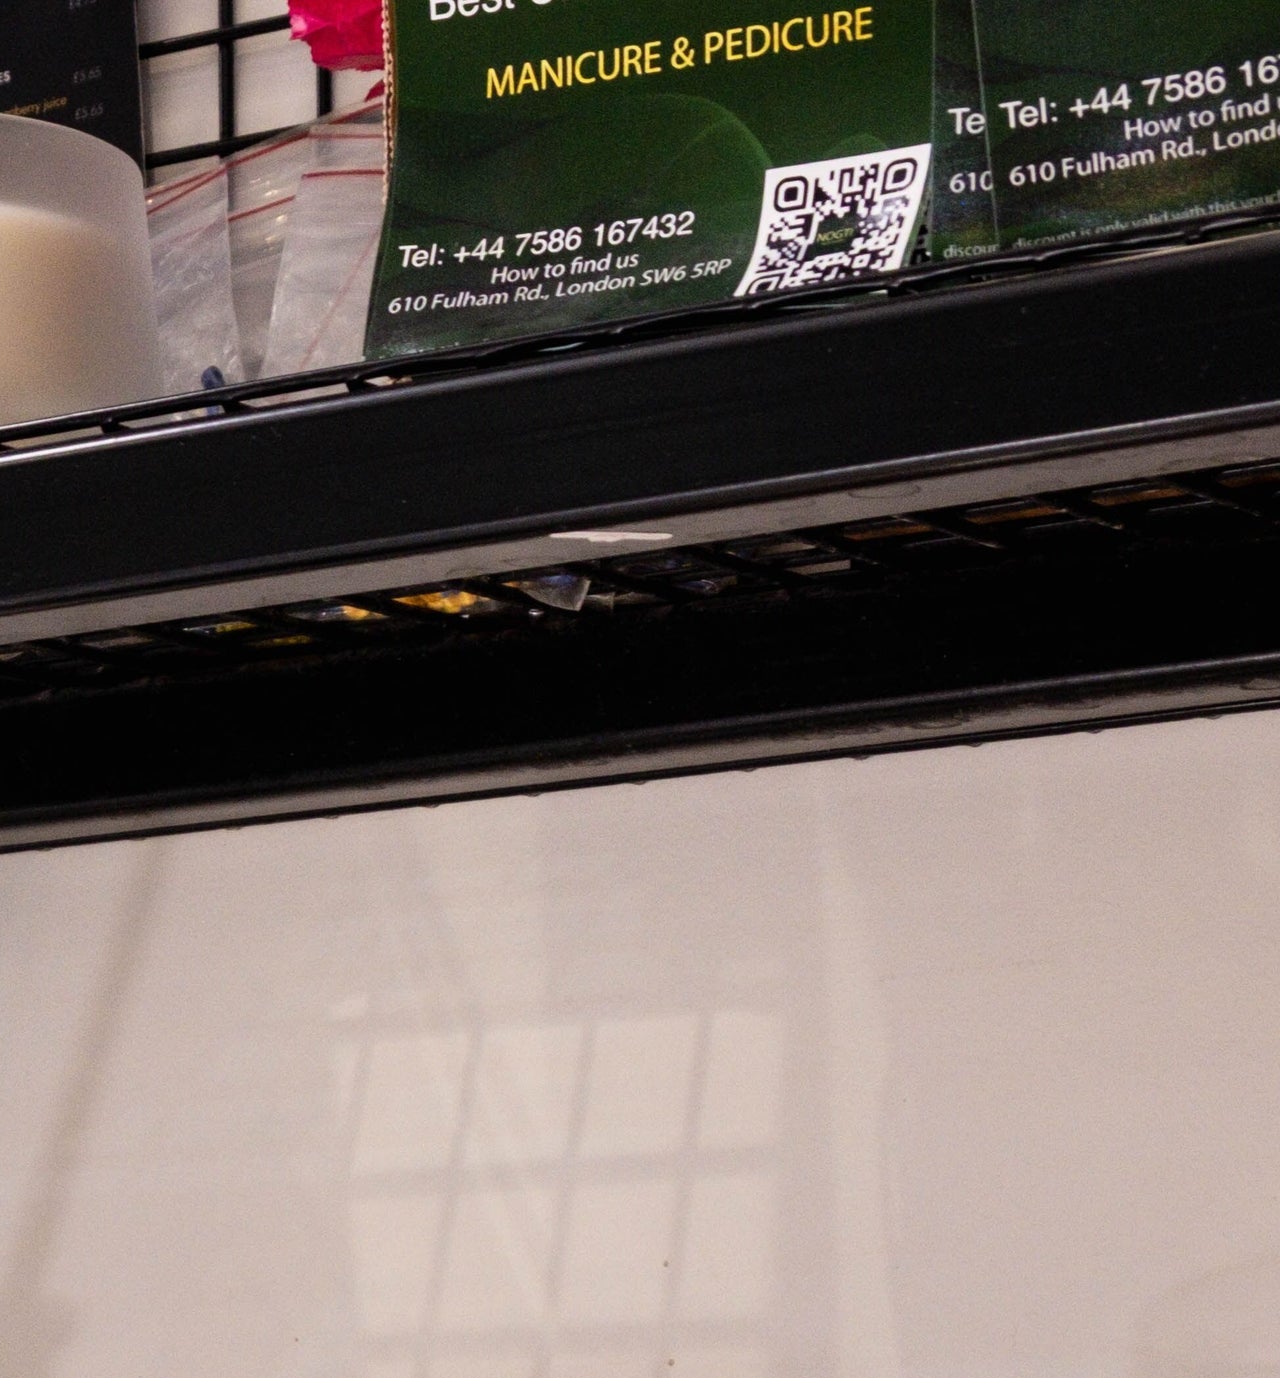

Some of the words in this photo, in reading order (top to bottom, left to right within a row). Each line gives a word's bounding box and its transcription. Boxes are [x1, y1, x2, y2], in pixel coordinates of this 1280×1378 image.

[485, 40, 663, 99] MANICURE
[671, 36, 695, 69] &
[704, 6, 874, 65] PEDICURE
[999, 97, 1058, 128] Tel:
[1069, 83, 1132, 119] +44
[1141, 66, 1226, 105] 7586
[1238, 55, 1280, 87] 16
[1124, 115, 1182, 141] How
[1188, 109, 1215, 128] to
[1221, 93, 1270, 123] find
[1009, 161, 1056, 187] 610
[1061, 148, 1155, 179] Fulham
[1213, 119, 1280, 151] Lond
[398, 243, 445, 268] Tel:
[453, 236, 505, 264] +44
[515, 226, 582, 256] 7586
[593, 210, 696, 248] 167432
[388, 295, 427, 314] 610
[431, 288, 509, 310] Fulham
[555, 273, 635, 298] London
[639, 264, 687, 287] SW6
[692, 257, 732, 279] 5RP
[491, 265, 539, 285] How
[543, 262, 566, 279] to
[571, 254, 610, 277] find
[616, 253, 639, 268] us
